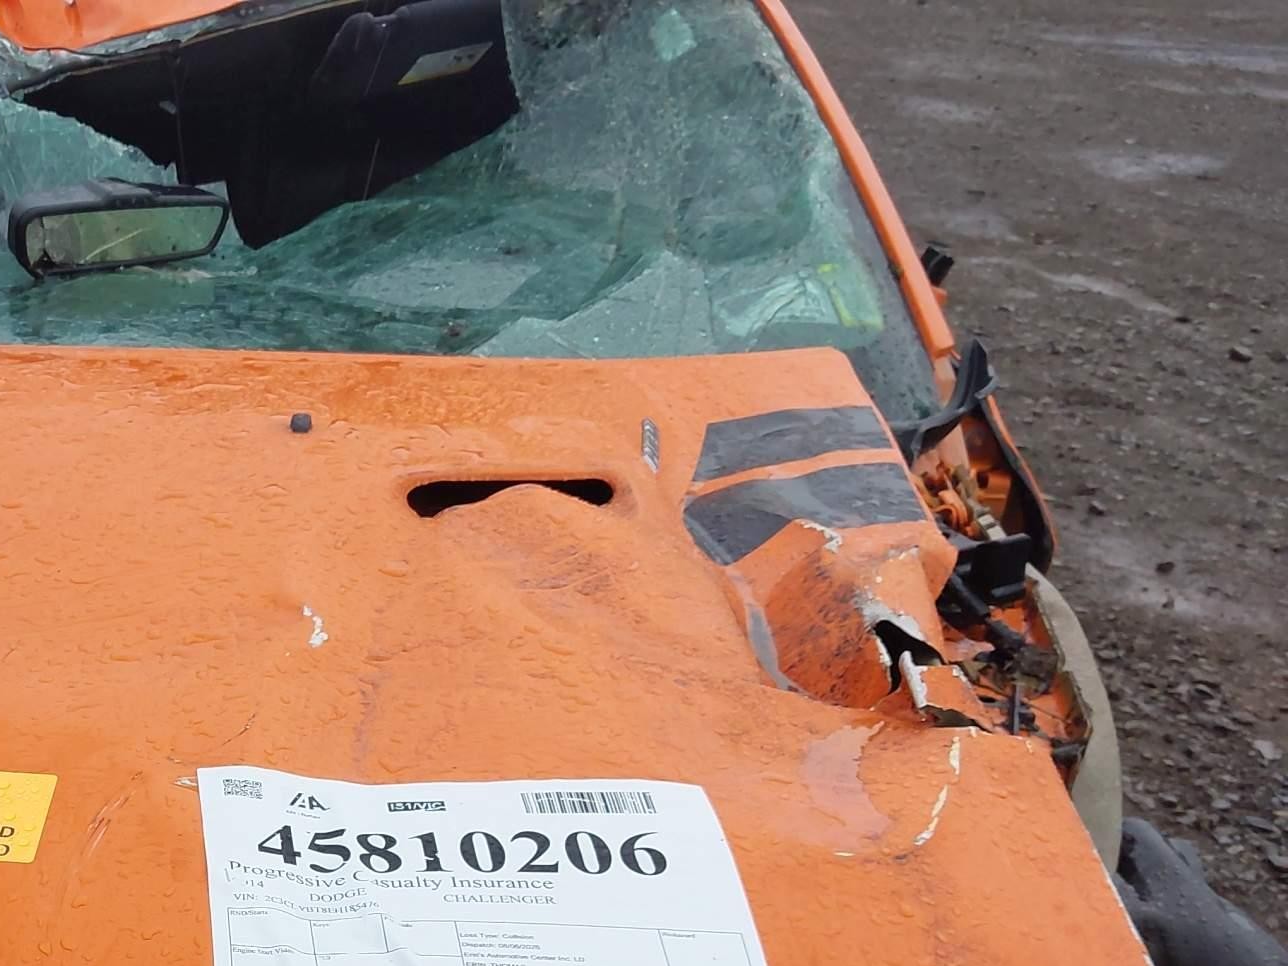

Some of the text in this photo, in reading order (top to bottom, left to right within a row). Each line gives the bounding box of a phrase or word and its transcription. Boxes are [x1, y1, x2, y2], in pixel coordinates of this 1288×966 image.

[257, 825, 668, 876] 45810206
[229, 860, 554, 890] Progressive Casualty Insurance
[233, 893, 259, 901] VIN:
[309, 887, 368, 902] DODGE
[443, 894, 557, 904] CHALLENGER
